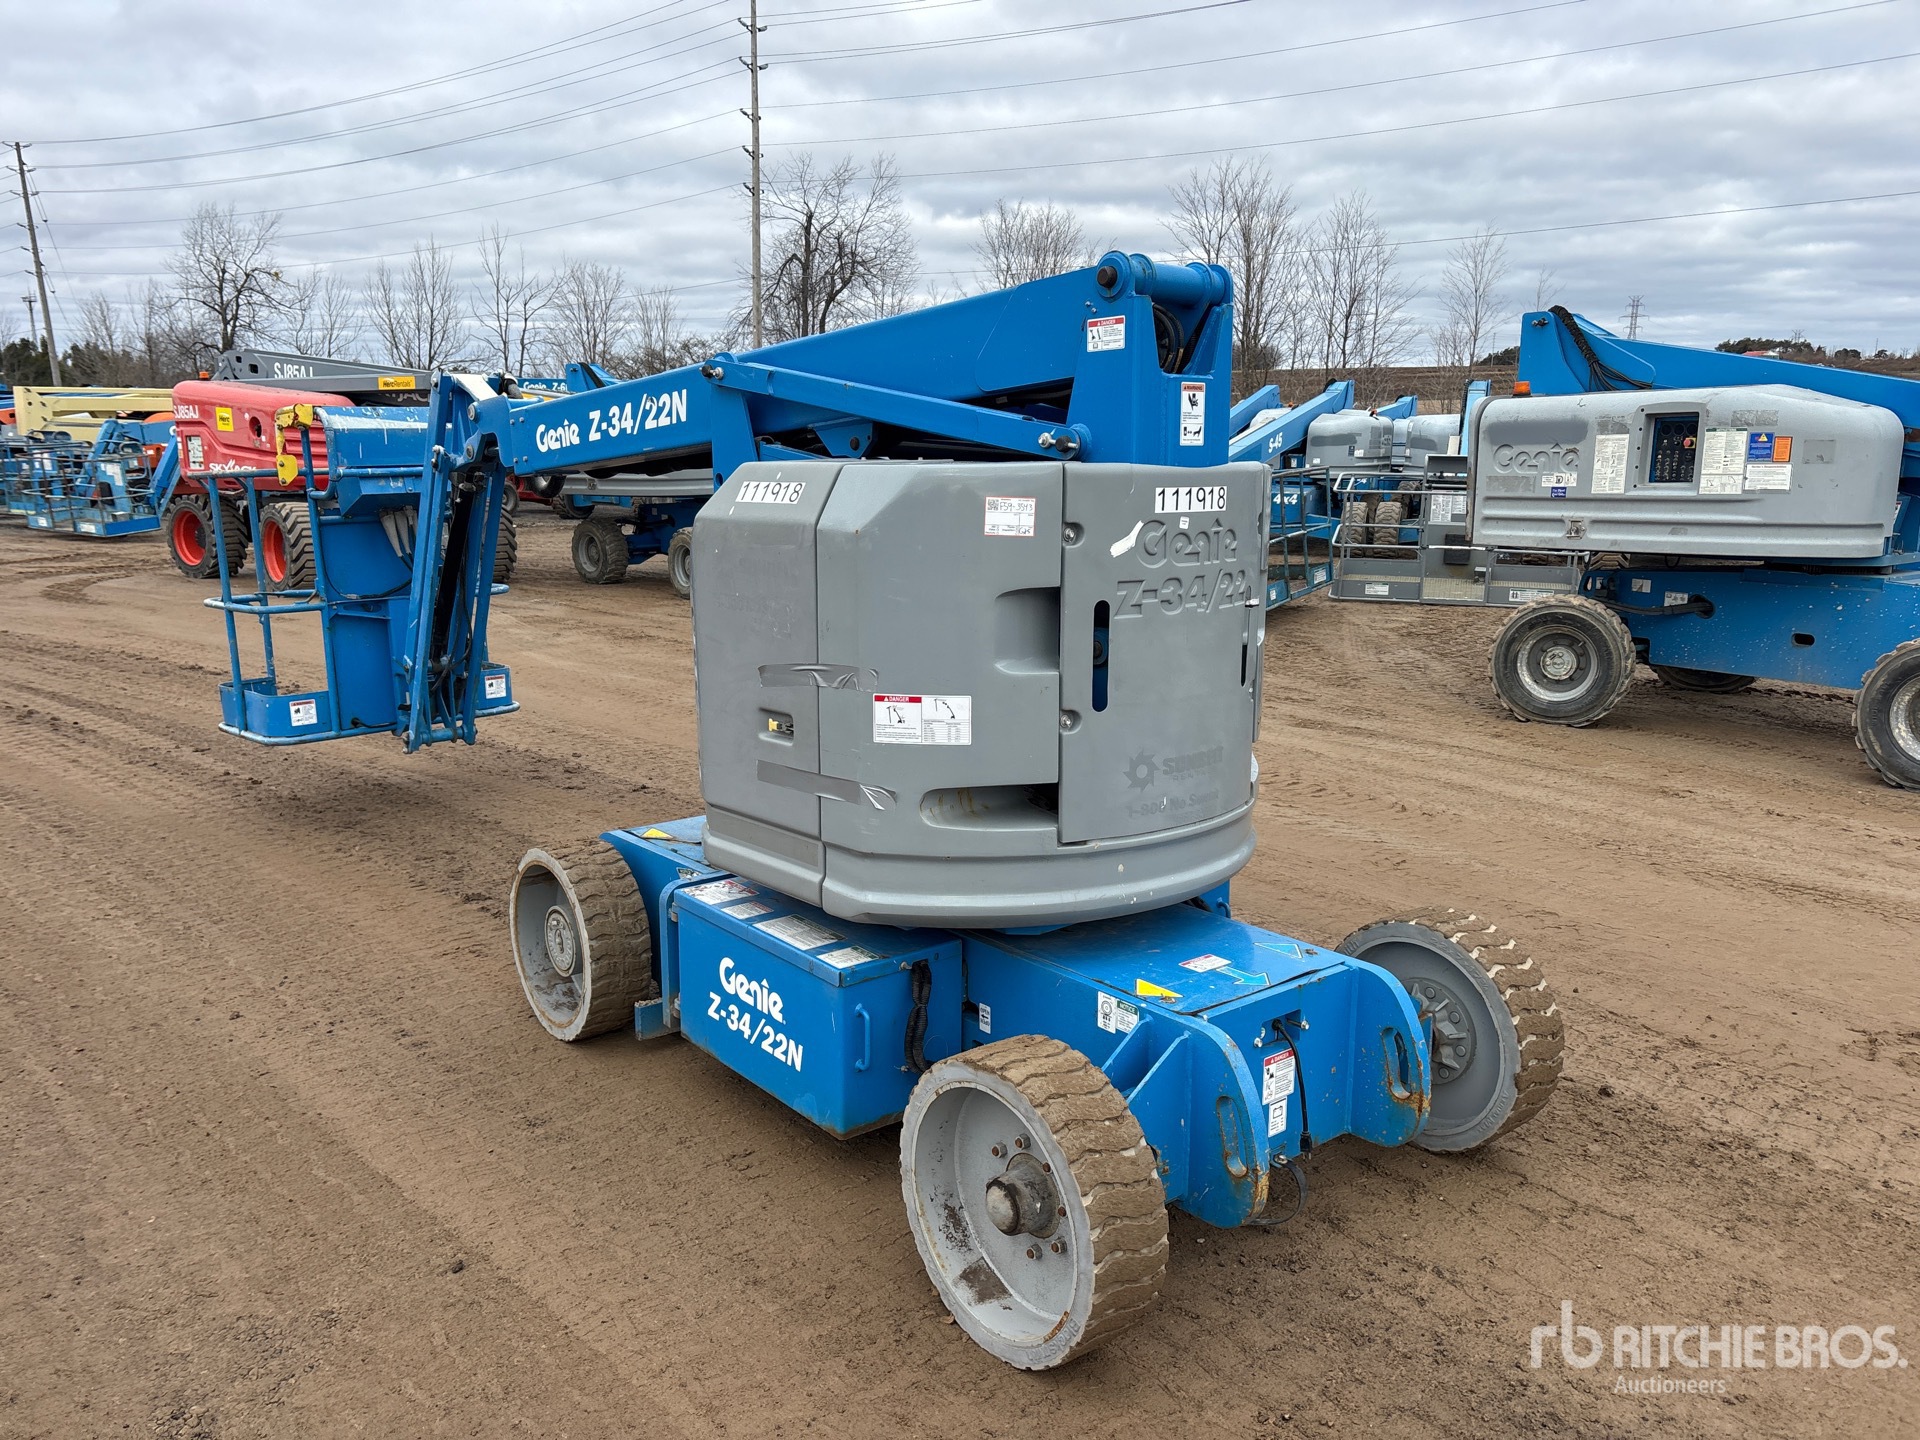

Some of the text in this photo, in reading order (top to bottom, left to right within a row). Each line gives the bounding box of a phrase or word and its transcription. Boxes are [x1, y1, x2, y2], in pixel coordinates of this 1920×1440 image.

[536, 389, 687, 452] Genie Z-34/22N
[1268, 432, 1283, 453] S-45
[1493, 443, 1580, 473] Genie
[740, 482, 803, 503] 111918
[1157, 487, 1226, 511] 111918
[1273, 493, 1298, 505] 4x4
[1136, 518, 1238, 568] Genie
[1114, 569, 1247, 619] Z-34/22
[719, 957, 784, 1024] Genie
[1120, 1001, 1136, 1014] NOTICE
[707, 991, 804, 1073] Z-34/22N
